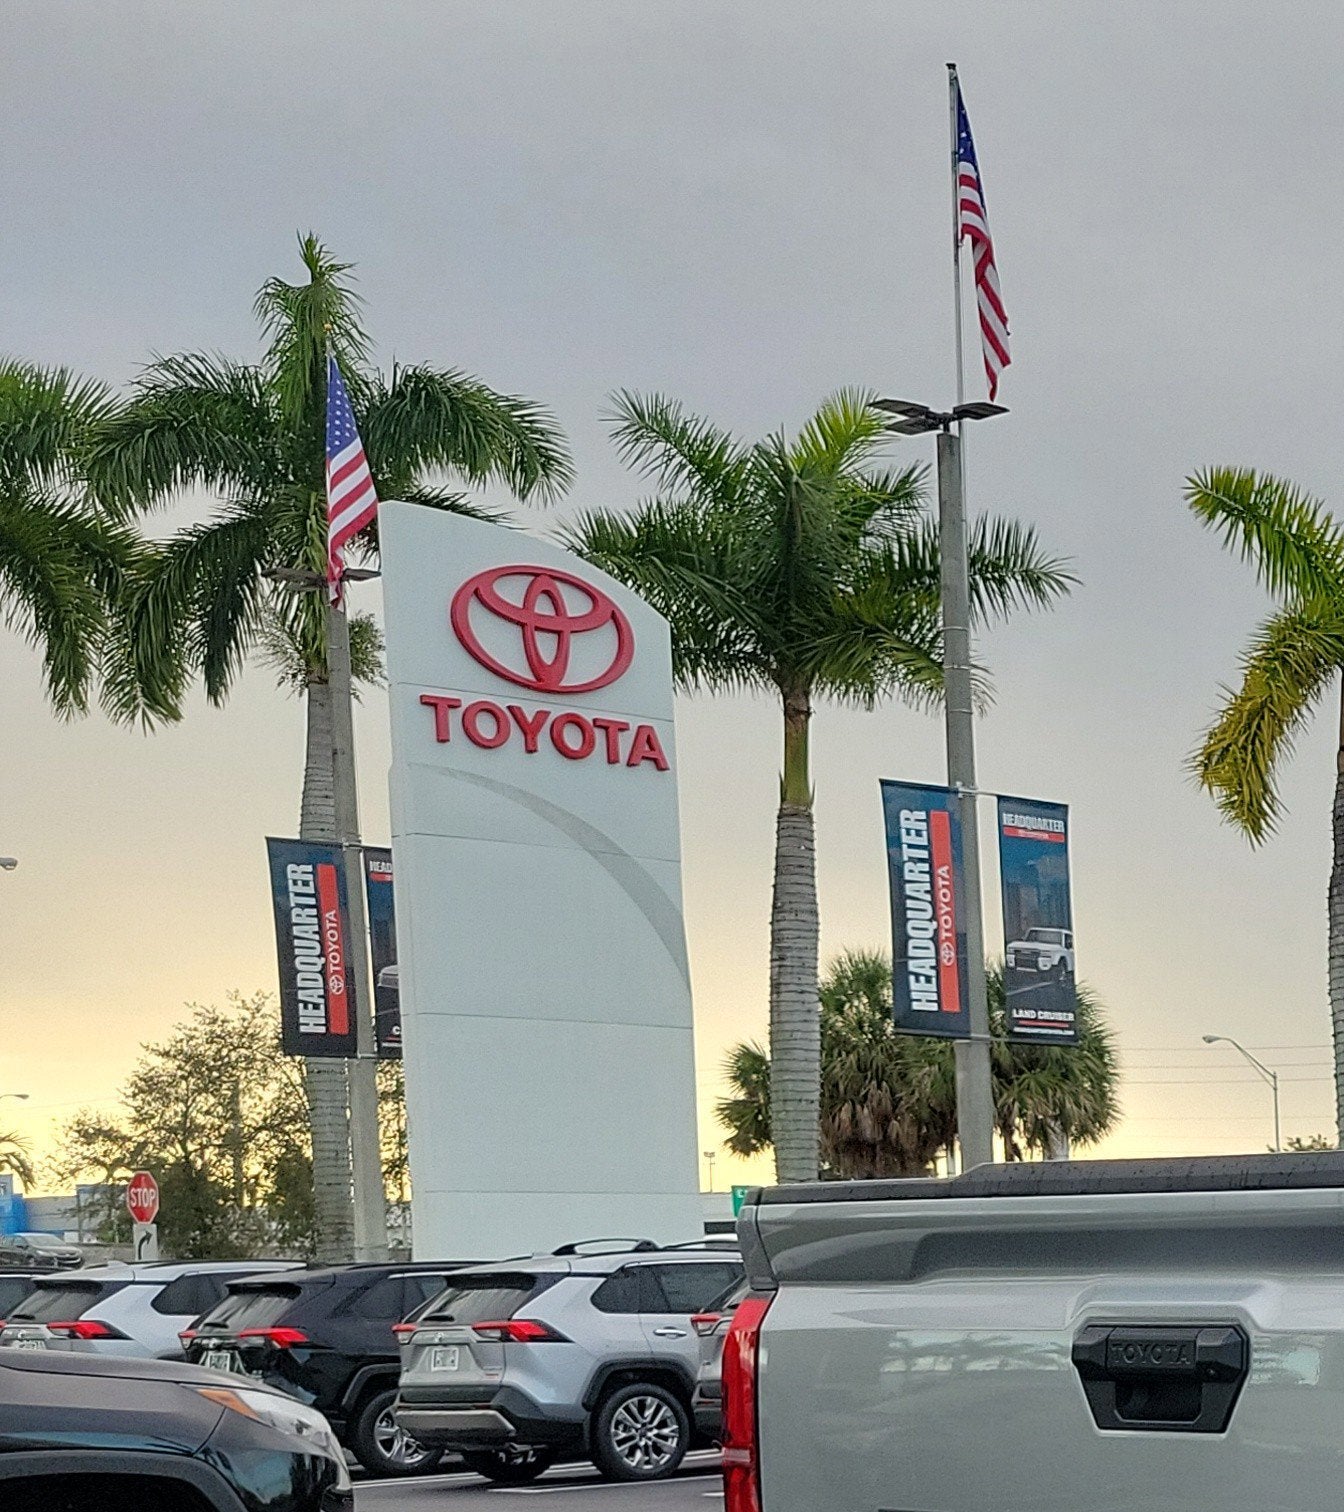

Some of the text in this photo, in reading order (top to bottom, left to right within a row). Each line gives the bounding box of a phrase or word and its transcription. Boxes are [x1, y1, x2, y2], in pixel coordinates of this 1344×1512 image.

[420, 695, 670, 771] TOYOTA
[900, 808, 938, 1012] HEADQUARTER
[938, 864, 954, 943] TOYOTA
[286, 863, 327, 1034] HEADQUARTER
[325, 909, 341, 974] TOYOTA
[1012, 1009, 1036, 1019] LAND
[130, 1187, 156, 1208] STOP
[1111, 1343, 1191, 1365] TOYOTA
